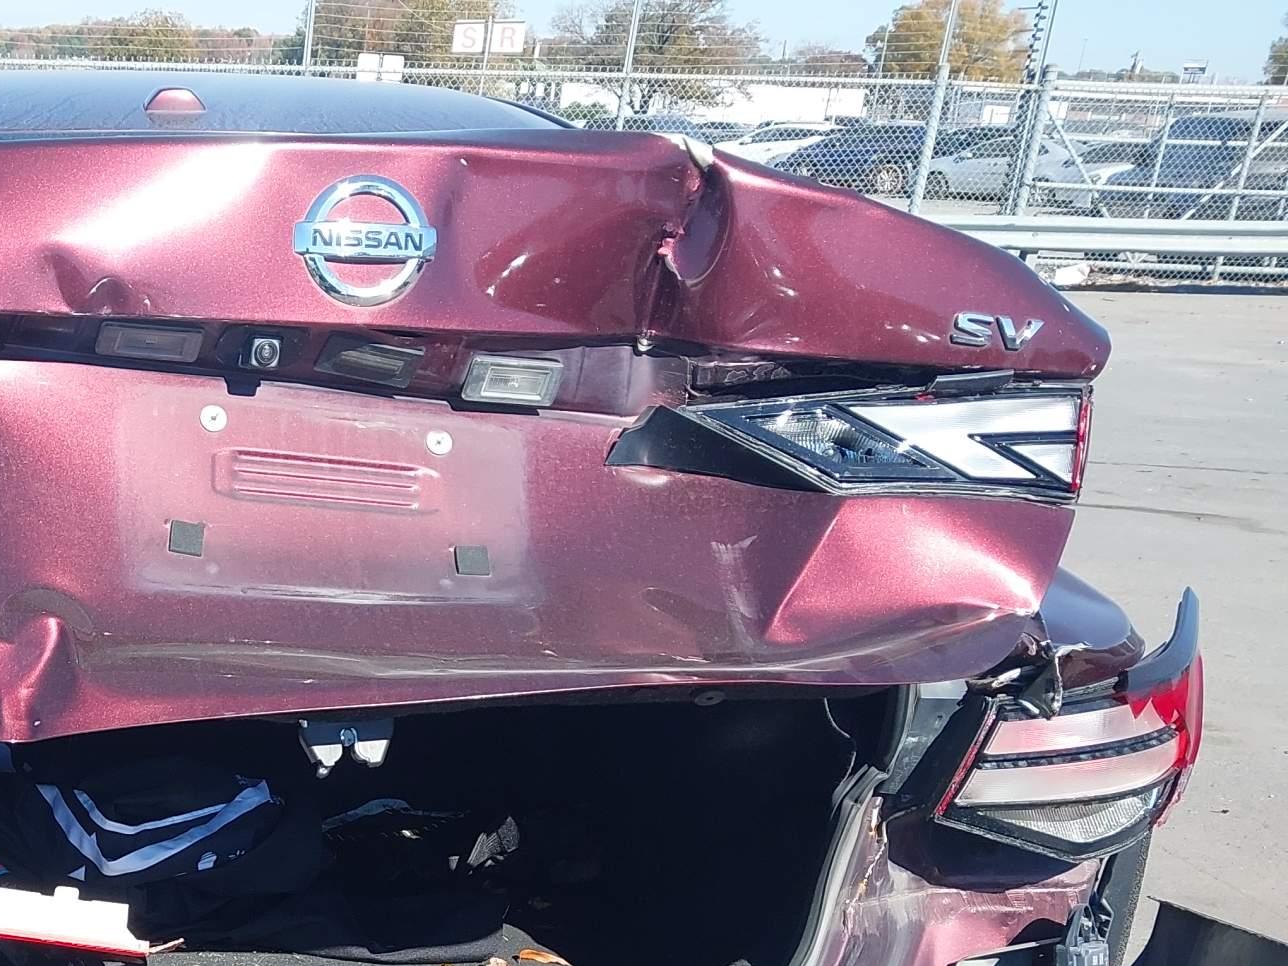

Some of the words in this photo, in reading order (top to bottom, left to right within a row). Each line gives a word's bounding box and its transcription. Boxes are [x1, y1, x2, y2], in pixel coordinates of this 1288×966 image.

[462, 26, 478, 49] S
[499, 26, 517, 49] R
[311, 228, 424, 252] NISSAN
[949, 311, 1045, 352] SV
